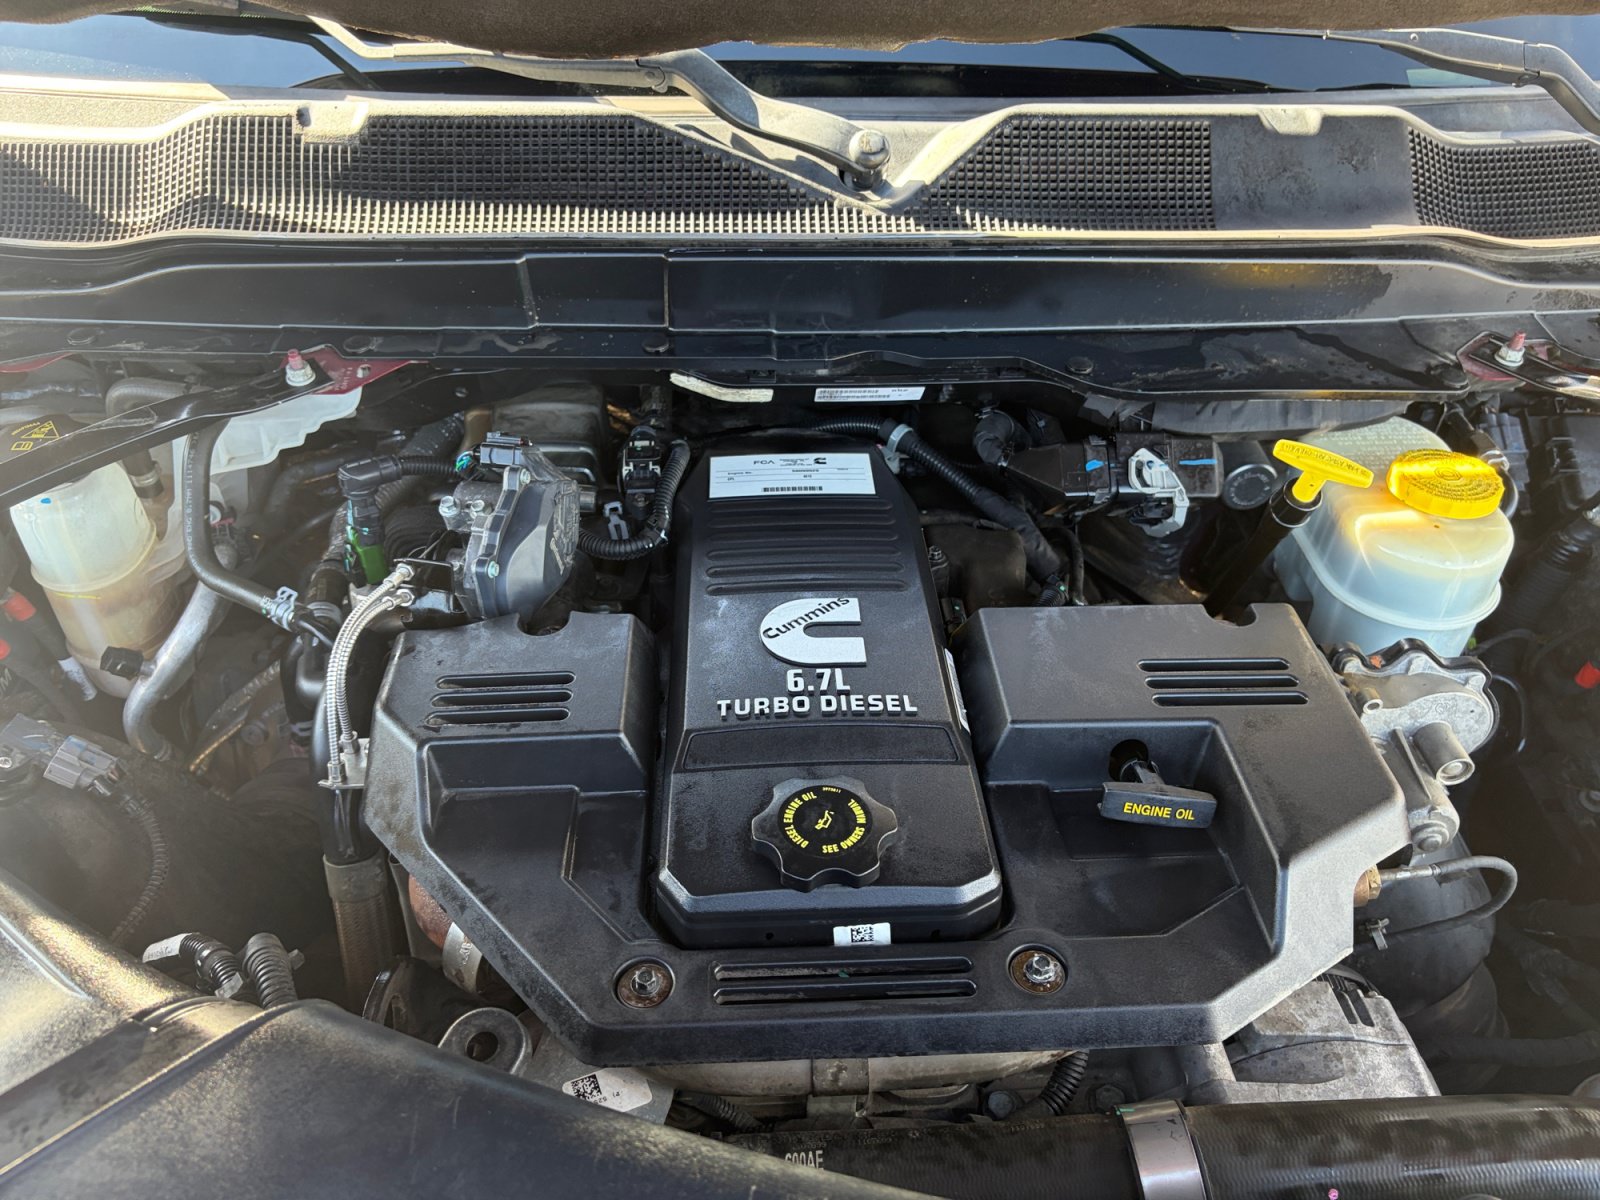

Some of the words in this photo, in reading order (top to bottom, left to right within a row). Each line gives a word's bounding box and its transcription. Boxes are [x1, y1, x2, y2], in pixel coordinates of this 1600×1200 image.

[762, 597, 850, 639] Cummins
[786, 668, 851, 694] 6.7L
[717, 696, 811, 720] TURBO
[820, 694, 918, 717] DIESEL
[801, 791, 817, 802] OIL
[783, 797, 803, 823] ENGINE
[848, 798, 867, 824] MANUAL
[1123, 802, 1172, 818] ENGINE
[1175, 808, 1196, 820] OIL
[784, 824, 809, 849] DIESEL
[822, 843, 840, 853] SEE
[840, 826, 865, 849] OWNERS
